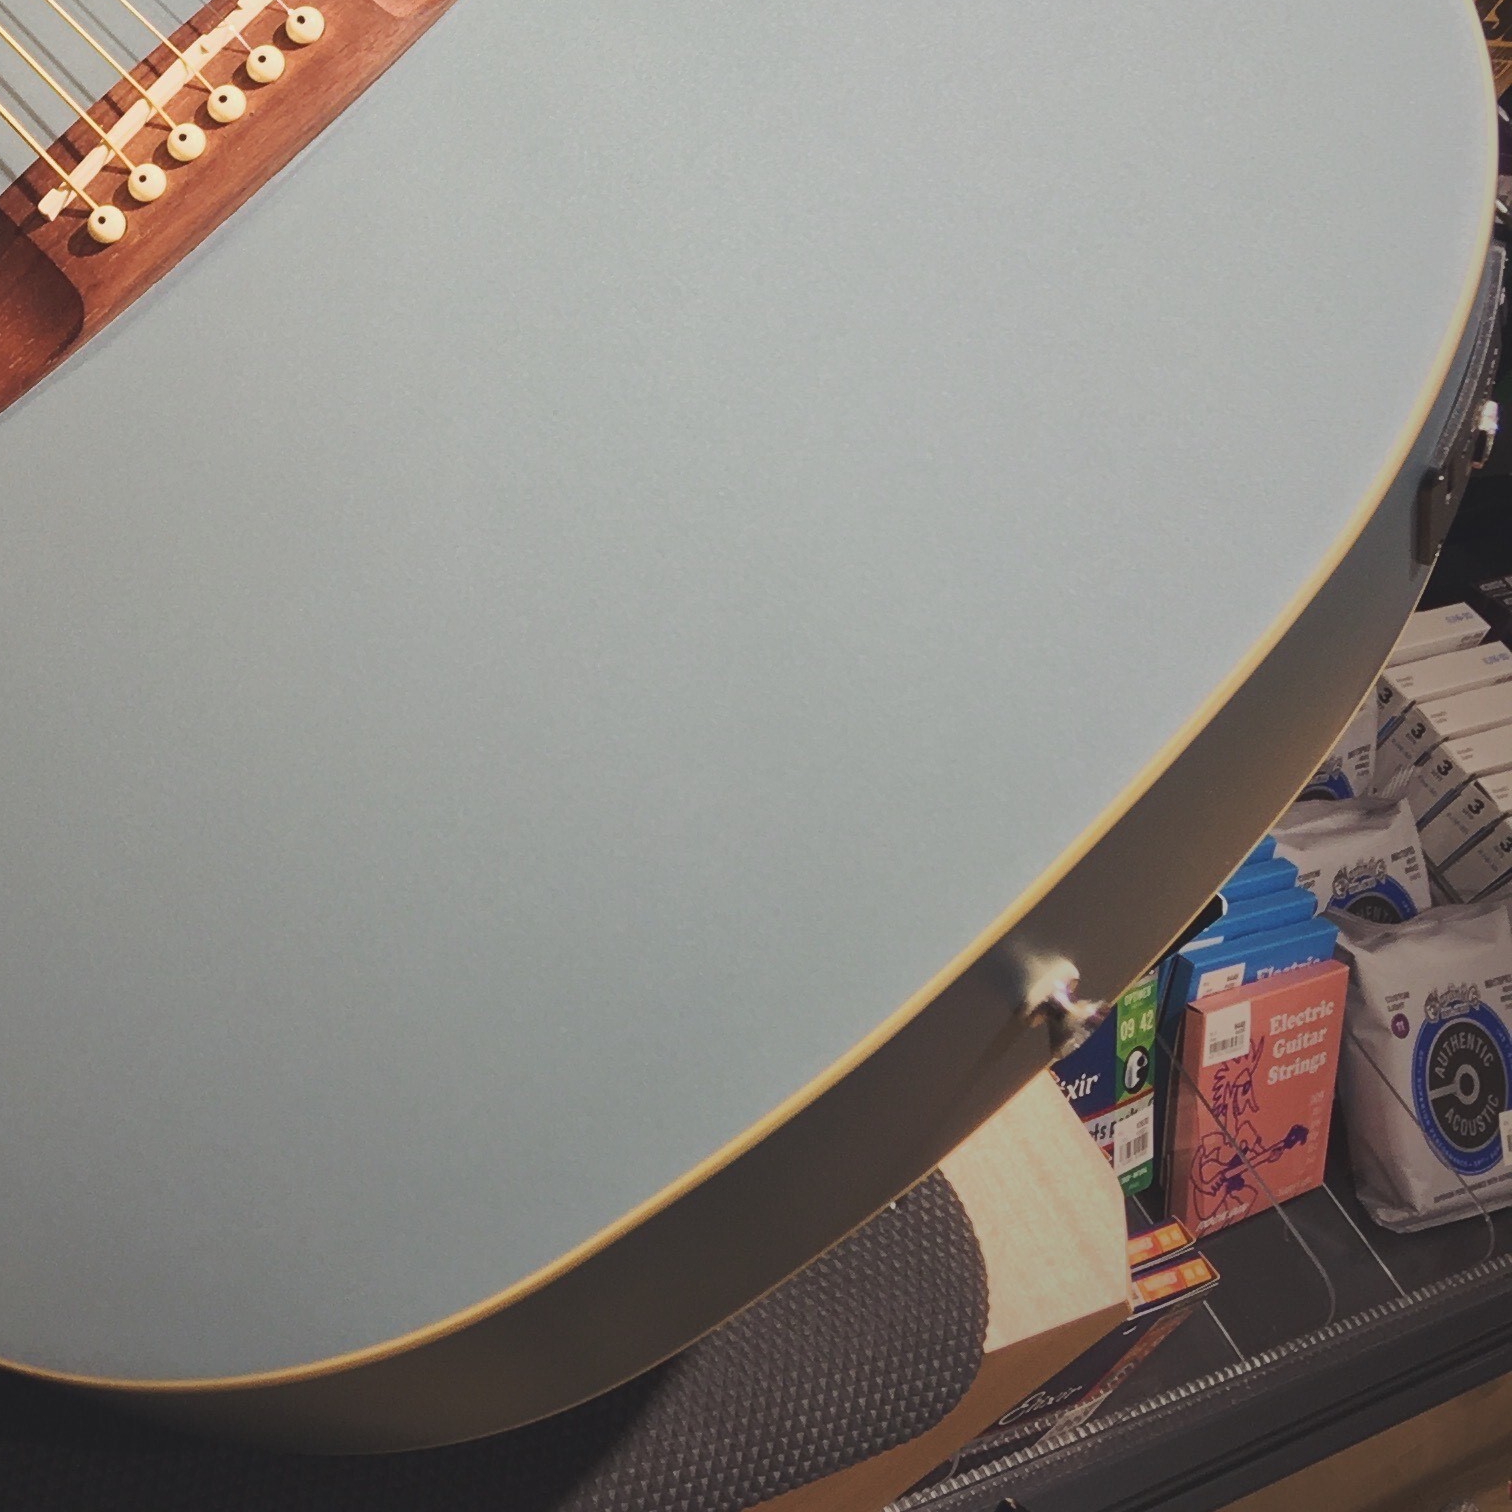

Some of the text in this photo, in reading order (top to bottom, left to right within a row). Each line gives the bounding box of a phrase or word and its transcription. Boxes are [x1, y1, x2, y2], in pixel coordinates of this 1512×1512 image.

[1410, 722, 1426, 740] 3
[1437, 759, 1453, 777] 3
[1467, 798, 1485, 816] 3
[1120, 1009, 1154, 1042] 09 42
[1269, 999, 1335, 1037] Electric
[1272, 1027, 1328, 1059] Guitar
[1434, 1031, 1495, 1079] AUTHENTIC
[1267, 1051, 1328, 1086] Strings
[1444, 1093, 1500, 1137] ACOUSTIC
